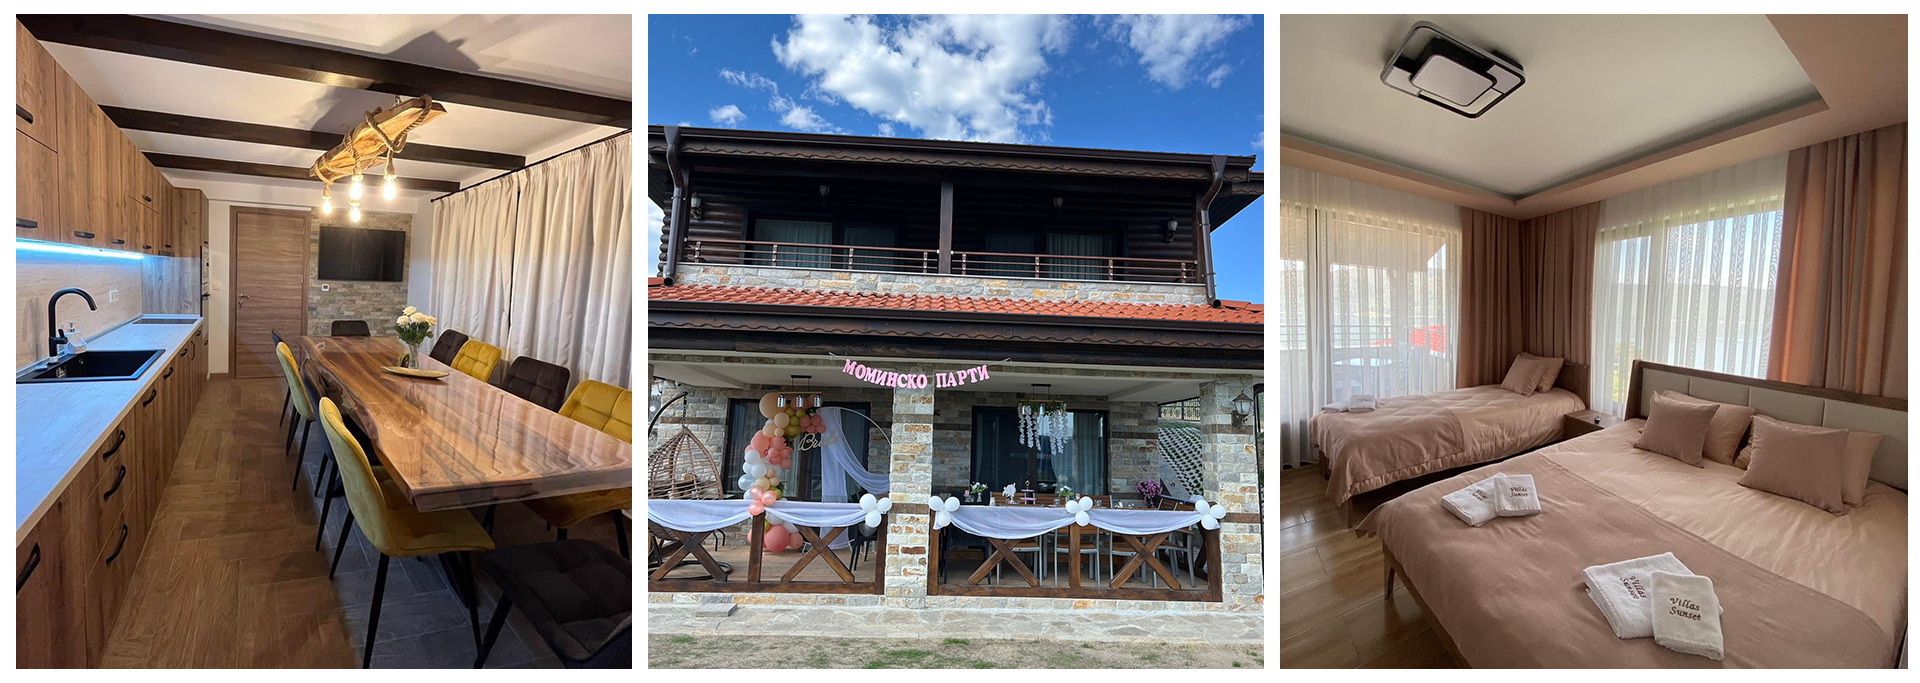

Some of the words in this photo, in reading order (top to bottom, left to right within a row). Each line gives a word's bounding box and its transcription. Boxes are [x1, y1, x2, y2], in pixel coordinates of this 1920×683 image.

[842, 358, 928, 389] МОМИНСКО
[935, 364, 990, 388] ПАРТИ
[1629, 575, 1647, 599] Villas
[1669, 597, 1700, 611] Villas
[1669, 606, 1702, 621] Sunset
